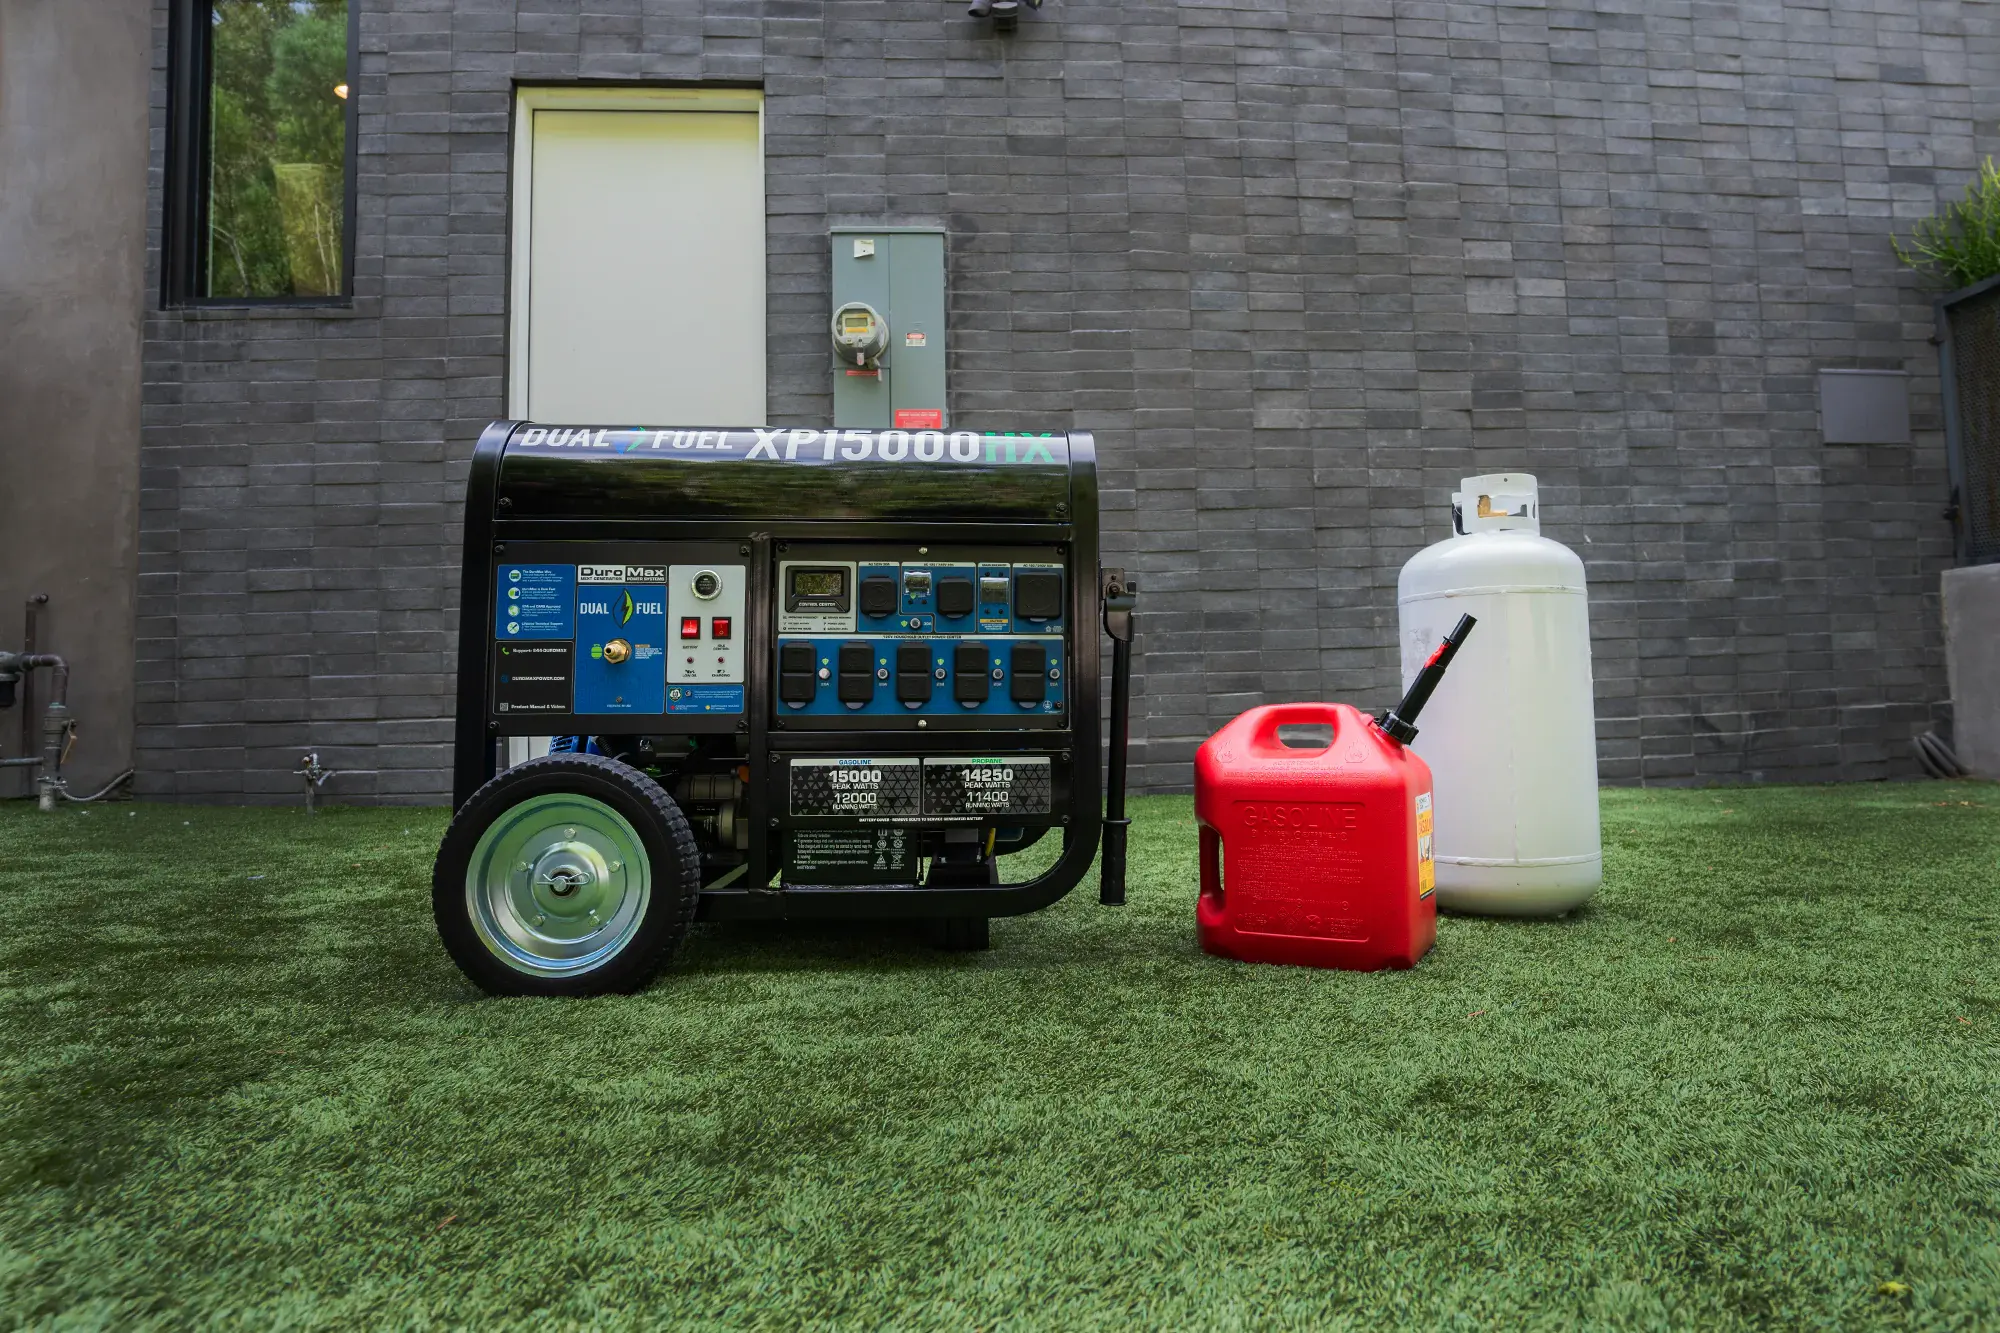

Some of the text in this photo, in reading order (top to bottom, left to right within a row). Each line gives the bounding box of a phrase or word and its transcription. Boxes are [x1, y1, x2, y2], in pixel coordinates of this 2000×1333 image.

[519, 428, 611, 447] DUAL
[651, 430, 733, 449] FUEL
[580, 602, 664, 614] DUAL FUEL
[828, 770, 882, 783] 15000
[962, 768, 1014, 782] 14250
[834, 792, 877, 804] 12000
[966, 792, 1009, 802] 11400
[1244, 806, 1356, 828] GASOLINE
